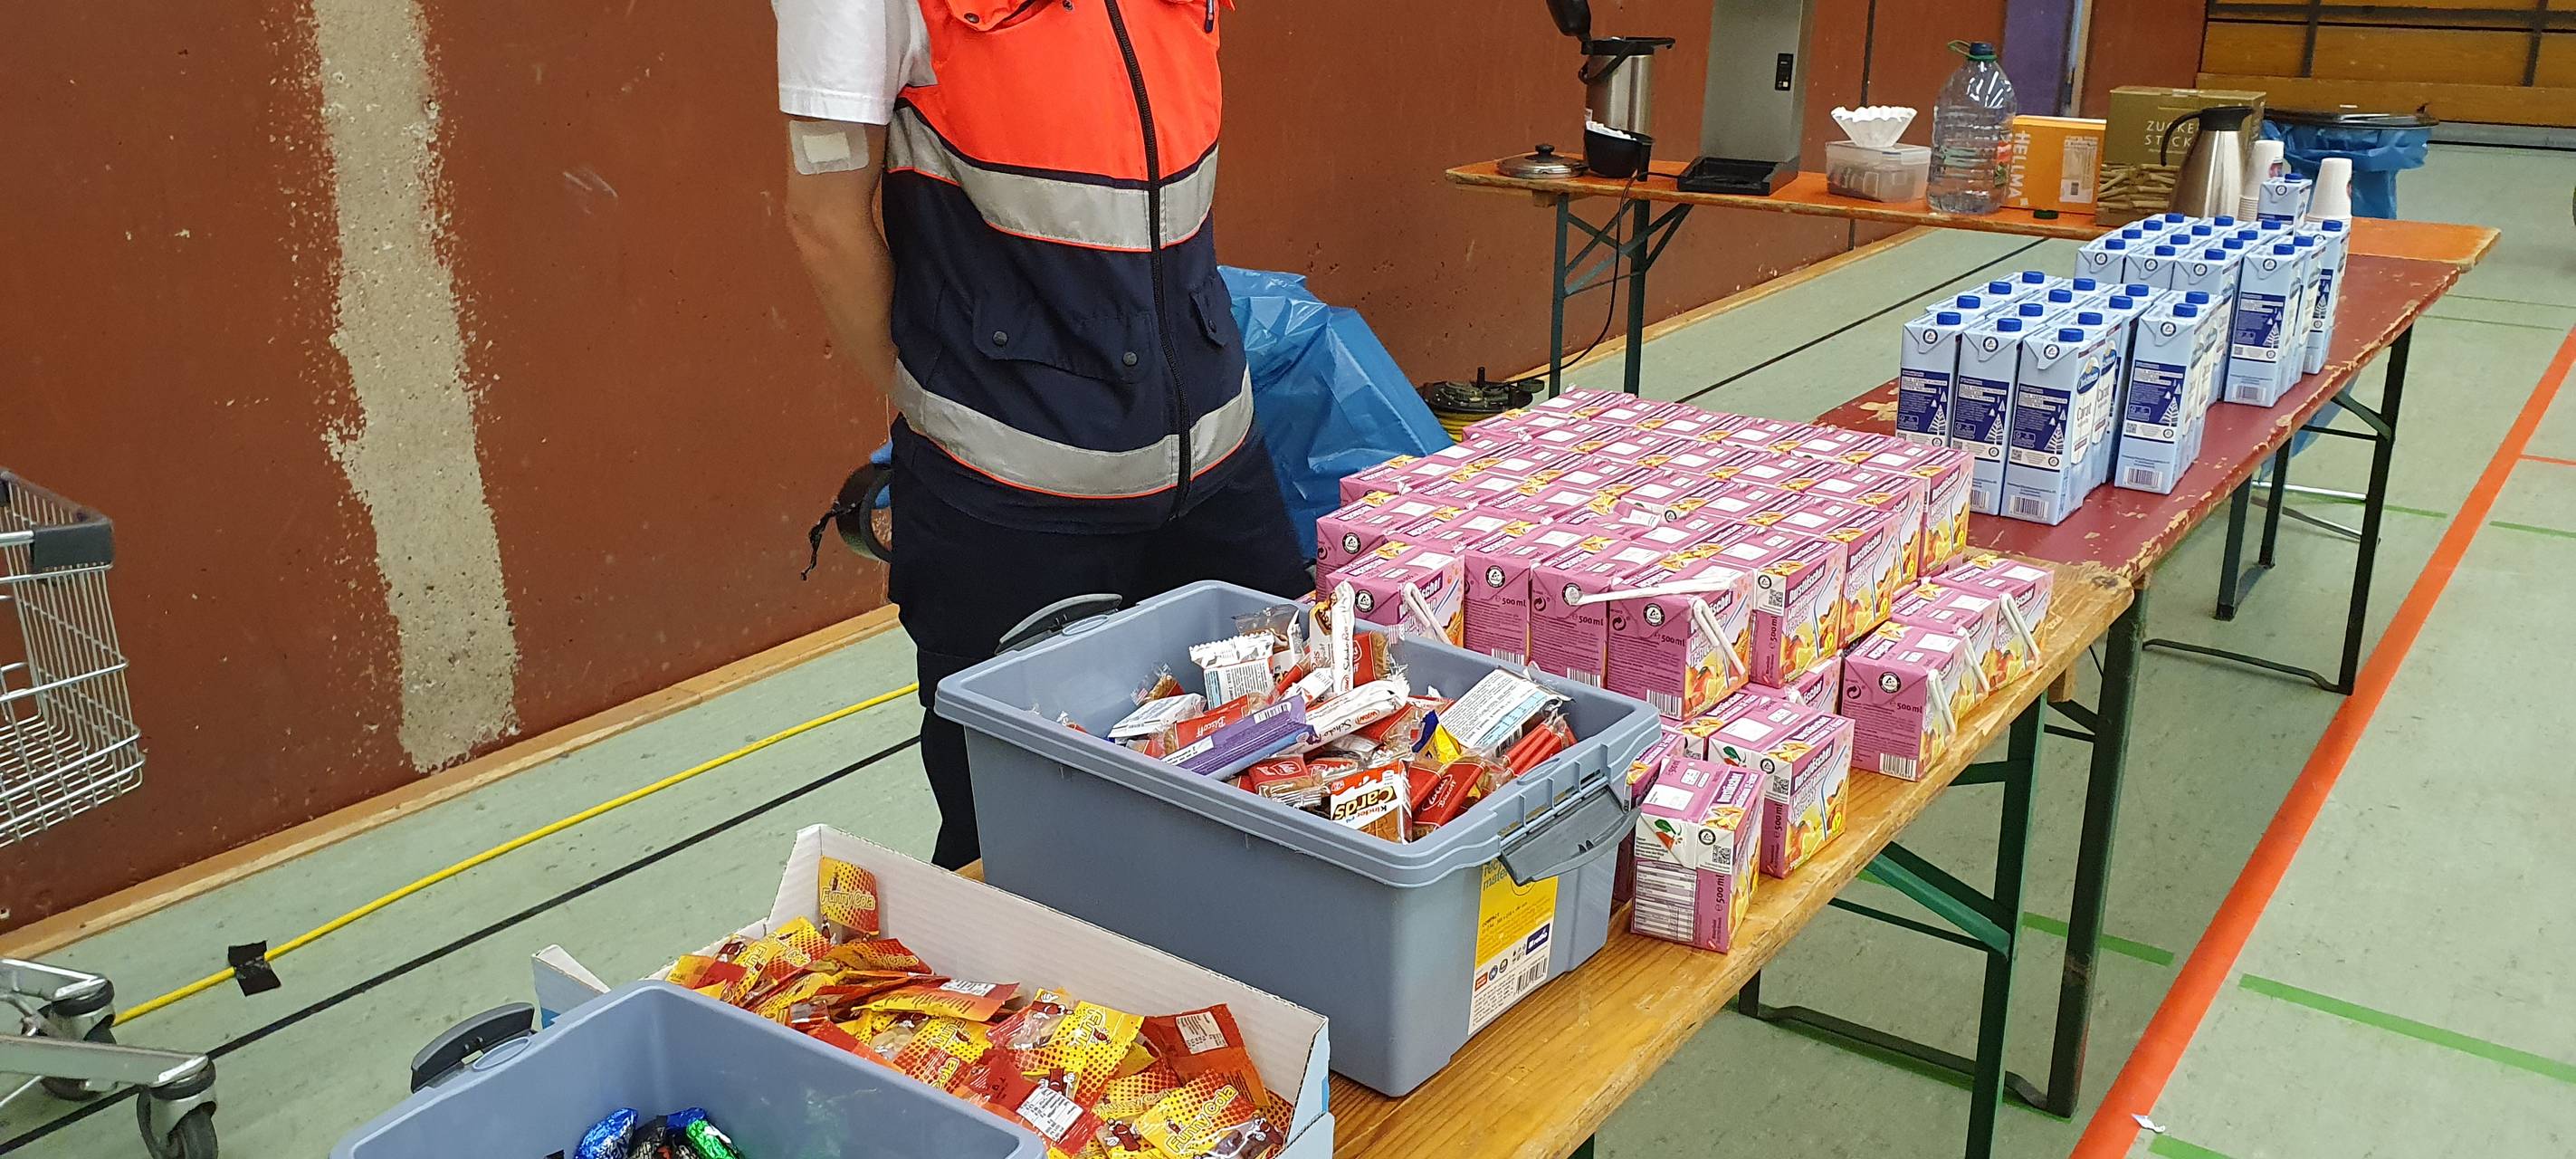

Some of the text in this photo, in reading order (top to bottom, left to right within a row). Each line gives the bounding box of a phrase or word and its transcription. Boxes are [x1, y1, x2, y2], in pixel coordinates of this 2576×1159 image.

[2146, 120, 2199, 133] ZUKE
[2144, 135, 2194, 148] STCK
[2008, 130, 2031, 198] HELLMA
[1196, 715, 1226, 738] Biscoff
[821, 887, 875, 911] Funny Cola
[1165, 1084, 1239, 1153] Funny Cola
